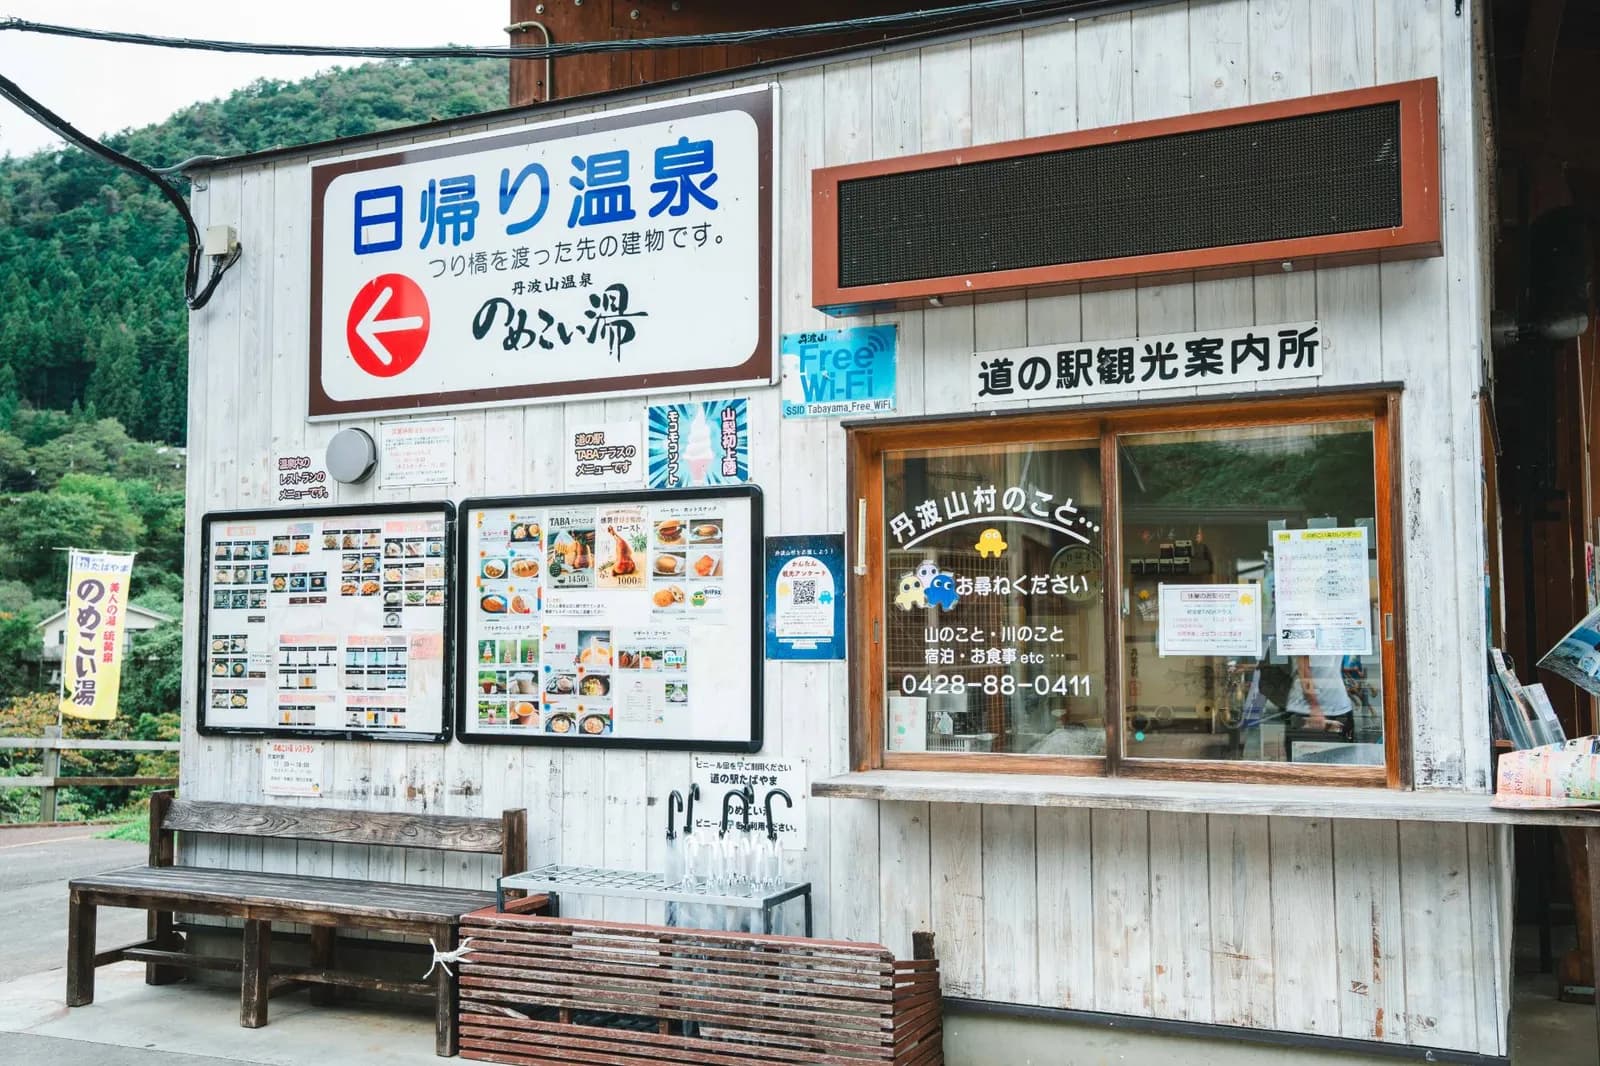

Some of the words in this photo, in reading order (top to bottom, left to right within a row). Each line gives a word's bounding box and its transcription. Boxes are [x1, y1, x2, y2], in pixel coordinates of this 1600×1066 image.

[354, 136, 719, 256] 日帰り温泉
[429, 222, 724, 279] つり橋を渡った先の建物です。
[511, 272, 593, 297] 丹波山温泉
[472, 283, 649, 363] のめこい湯
[800, 344, 875, 373] Free
[978, 326, 1318, 397] 道の駅観光案内所
[800, 369, 874, 403] Wi-Fi
[786, 406, 805, 416] SSID
[575, 432, 604, 447] 道の駅
[667, 411, 679, 485] モコモコソフト
[721, 406, 737, 477] 山梨初上陸
[575, 445, 636, 461] TABAテラスの
[280, 471, 326, 486] レストランの
[576, 460, 632, 476] メニューです
[279, 486, 328, 501] メニューです。
[550, 517, 570, 526] TABA
[956, 574, 1088, 596] お尋ねください
[72, 579, 105, 706] のめこい湯
[925, 626, 1065, 643] 山のこと・川のこと
[902, 674, 1092, 697] 0428-88-0411
[710, 773, 778, 786] 道の駅たばやま
